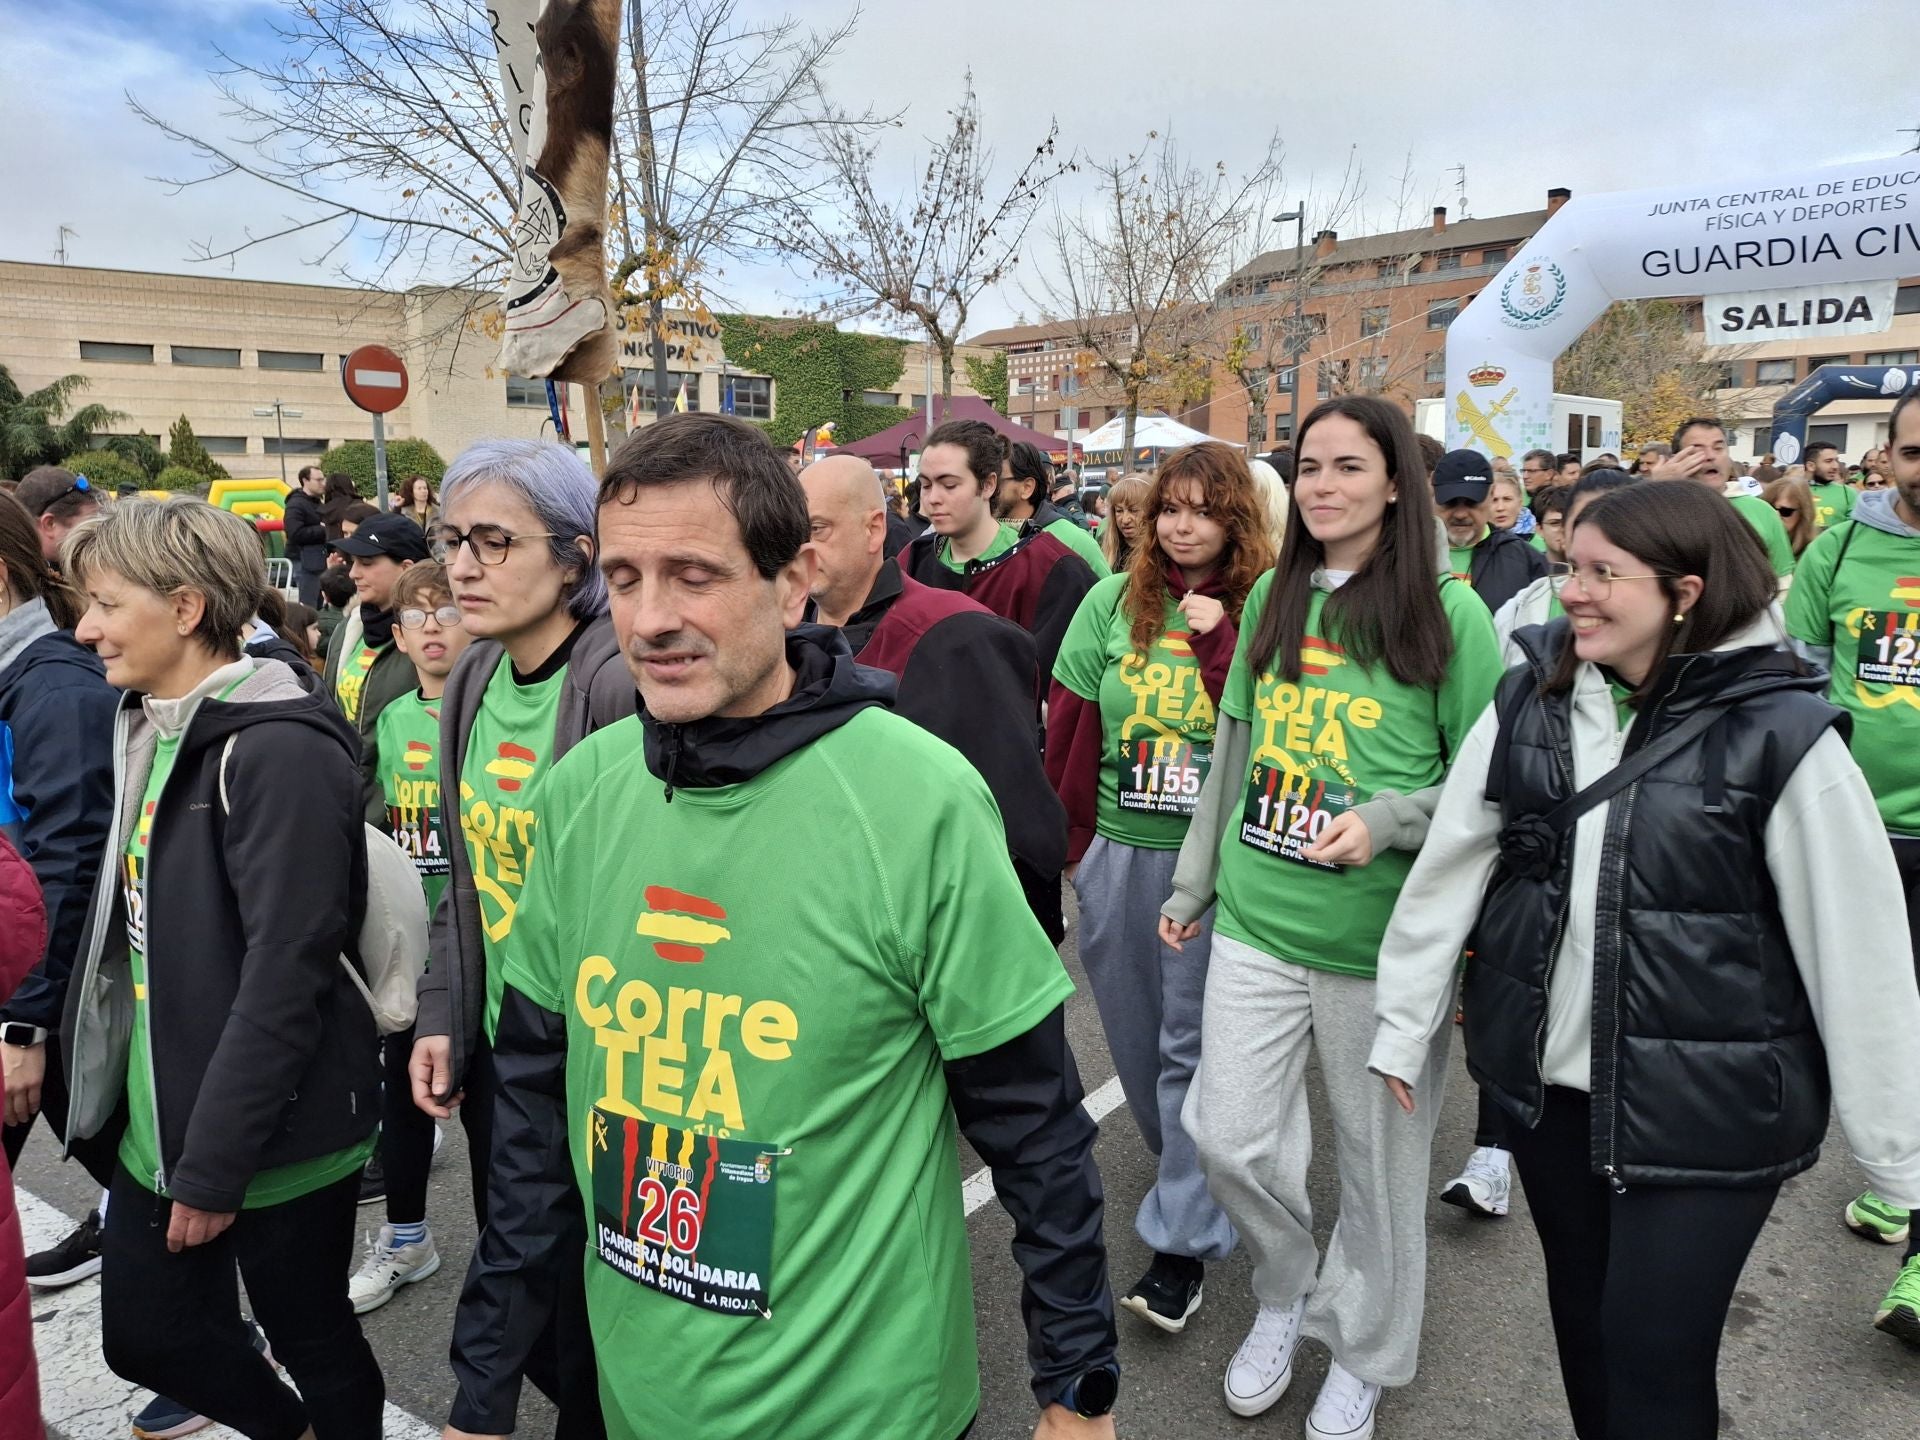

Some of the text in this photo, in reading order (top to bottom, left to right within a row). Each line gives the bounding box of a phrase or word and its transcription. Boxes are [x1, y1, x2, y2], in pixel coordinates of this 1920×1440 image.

[1647, 198, 1711, 217] JUNTA
[1716, 186, 1809, 208] CENTRAL
[1816, 180, 1846, 196] DE
[1705, 193, 1908, 232] FÍSICA Y DEPORTES
[1641, 232, 1843, 278] GUARDIA
[1721, 295, 1874, 333] SALIDA
[1105, 451, 1124, 464] CIV
[1120, 653, 1205, 692] Corr
[1864, 663, 1908, 675] CARRERA
[1864, 672, 1904, 683] GUARDIA
[1130, 684, 1216, 724] TEA
[1255, 672, 1383, 729] Corre
[1261, 708, 1348, 761] TEA
[394, 772, 440, 807] Corr
[1131, 763, 1200, 794] 1155
[1303, 756, 1358, 787] AUTISMO
[1124, 791, 1200, 804] CARRERA SOLIDAR
[1124, 800, 1156, 809] GUARDIA
[1157, 803, 1179, 811] CIVIL
[1246, 823, 1283, 844] CARRERA
[1257, 794, 1332, 841] 1120
[392, 828, 442, 857] 1214
[1245, 834, 1304, 860] GUARDIA CIVIL
[575, 955, 799, 1061] Corre
[593, 1026, 746, 1131] TEA
[645, 1155, 695, 1184] VITTORIO
[637, 1177, 702, 1254] 26
[603, 1227, 761, 1292] CARRERA SOLIDARIA
[604, 1248, 758, 1311] GUARDIA CIVIL LA RIOJA
